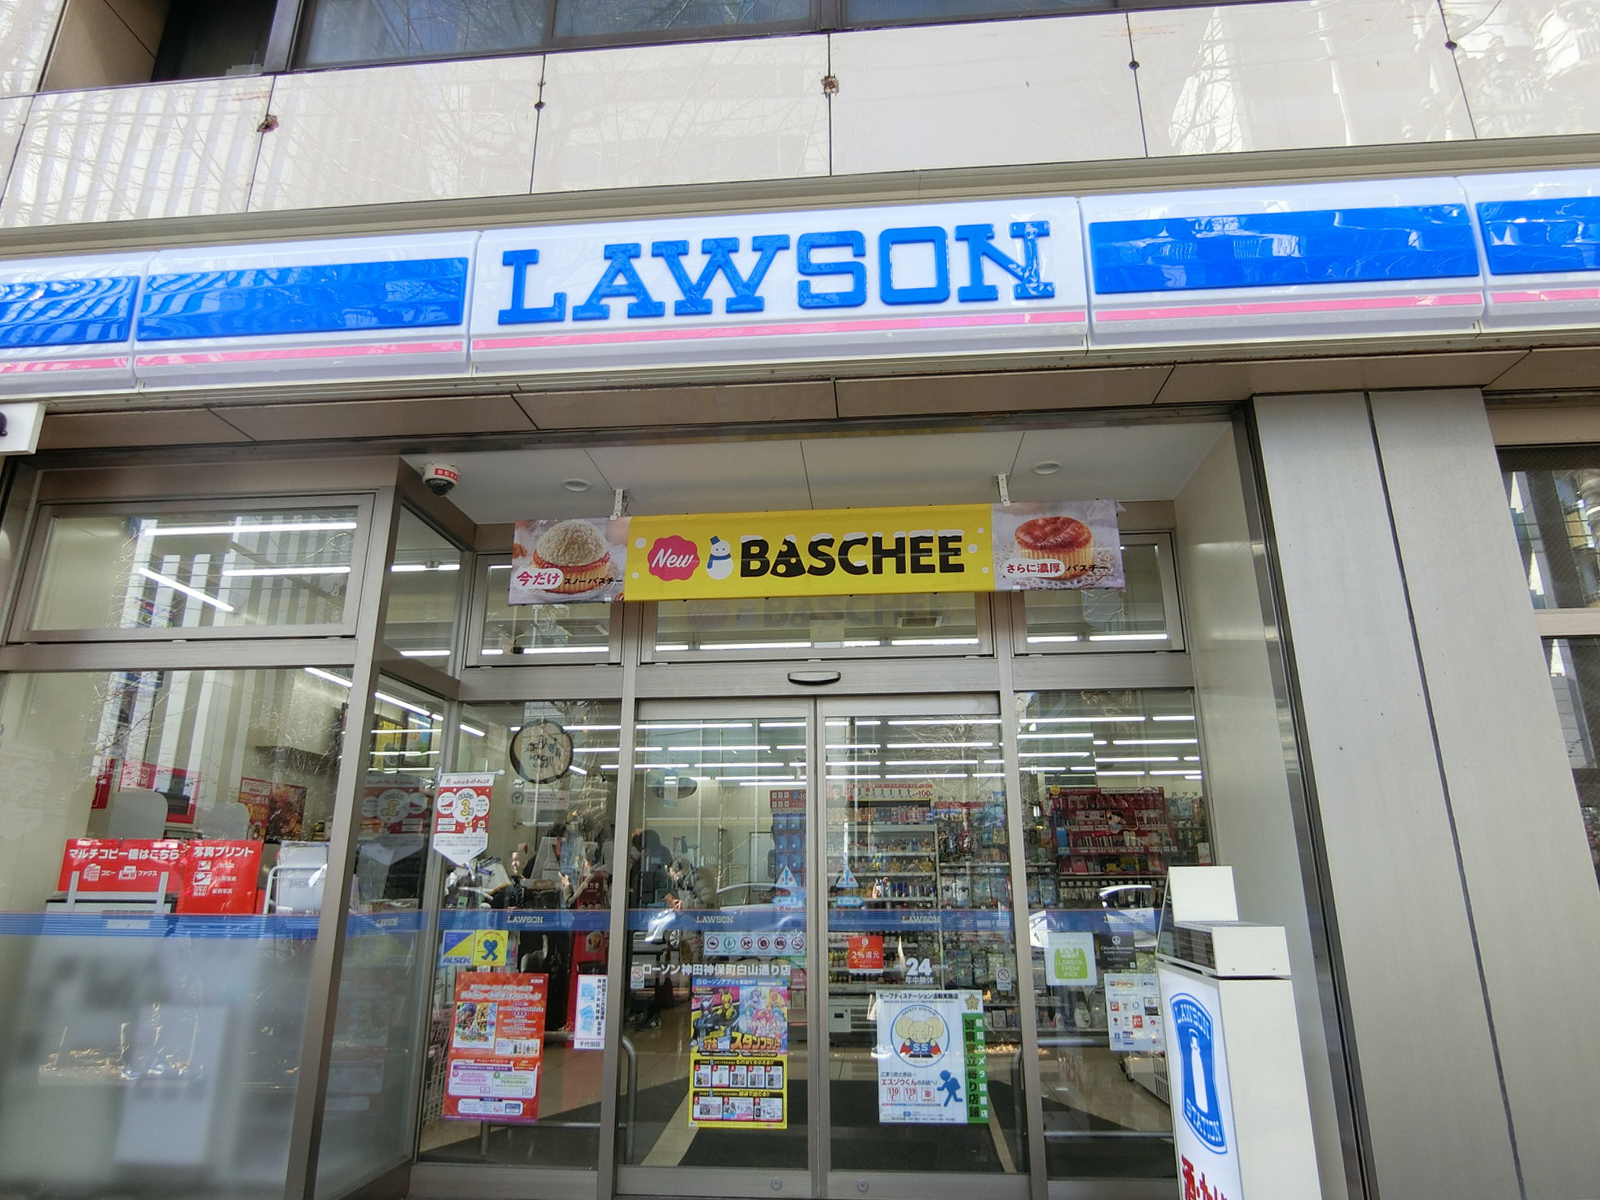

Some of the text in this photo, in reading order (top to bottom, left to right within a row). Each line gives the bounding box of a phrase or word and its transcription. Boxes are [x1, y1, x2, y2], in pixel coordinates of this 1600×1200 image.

[498, 221, 1056, 325] LAWSON
[652, 547, 694, 569] New
[740, 533, 965, 578] BASCHEE
[1006, 562, 1062, 574] さらに濃厚
[1066, 563, 1109, 573] バスチー
[516, 570, 560, 586] 今だけ
[69, 848, 180, 860] マルチコピー機はこちら
[193, 846, 254, 858] 写真プリント
[507, 915, 543, 924] LAWSON
[696, 915, 734, 924] LAWSON
[902, 915, 941, 924] LAWSON
[642, 963, 791, 977] ローソン神田神保町白山通り店
[906, 957, 933, 976] 24
[1174, 1003, 1211, 1040] LAWSON
[1185, 1097, 1222, 1143] STATION
